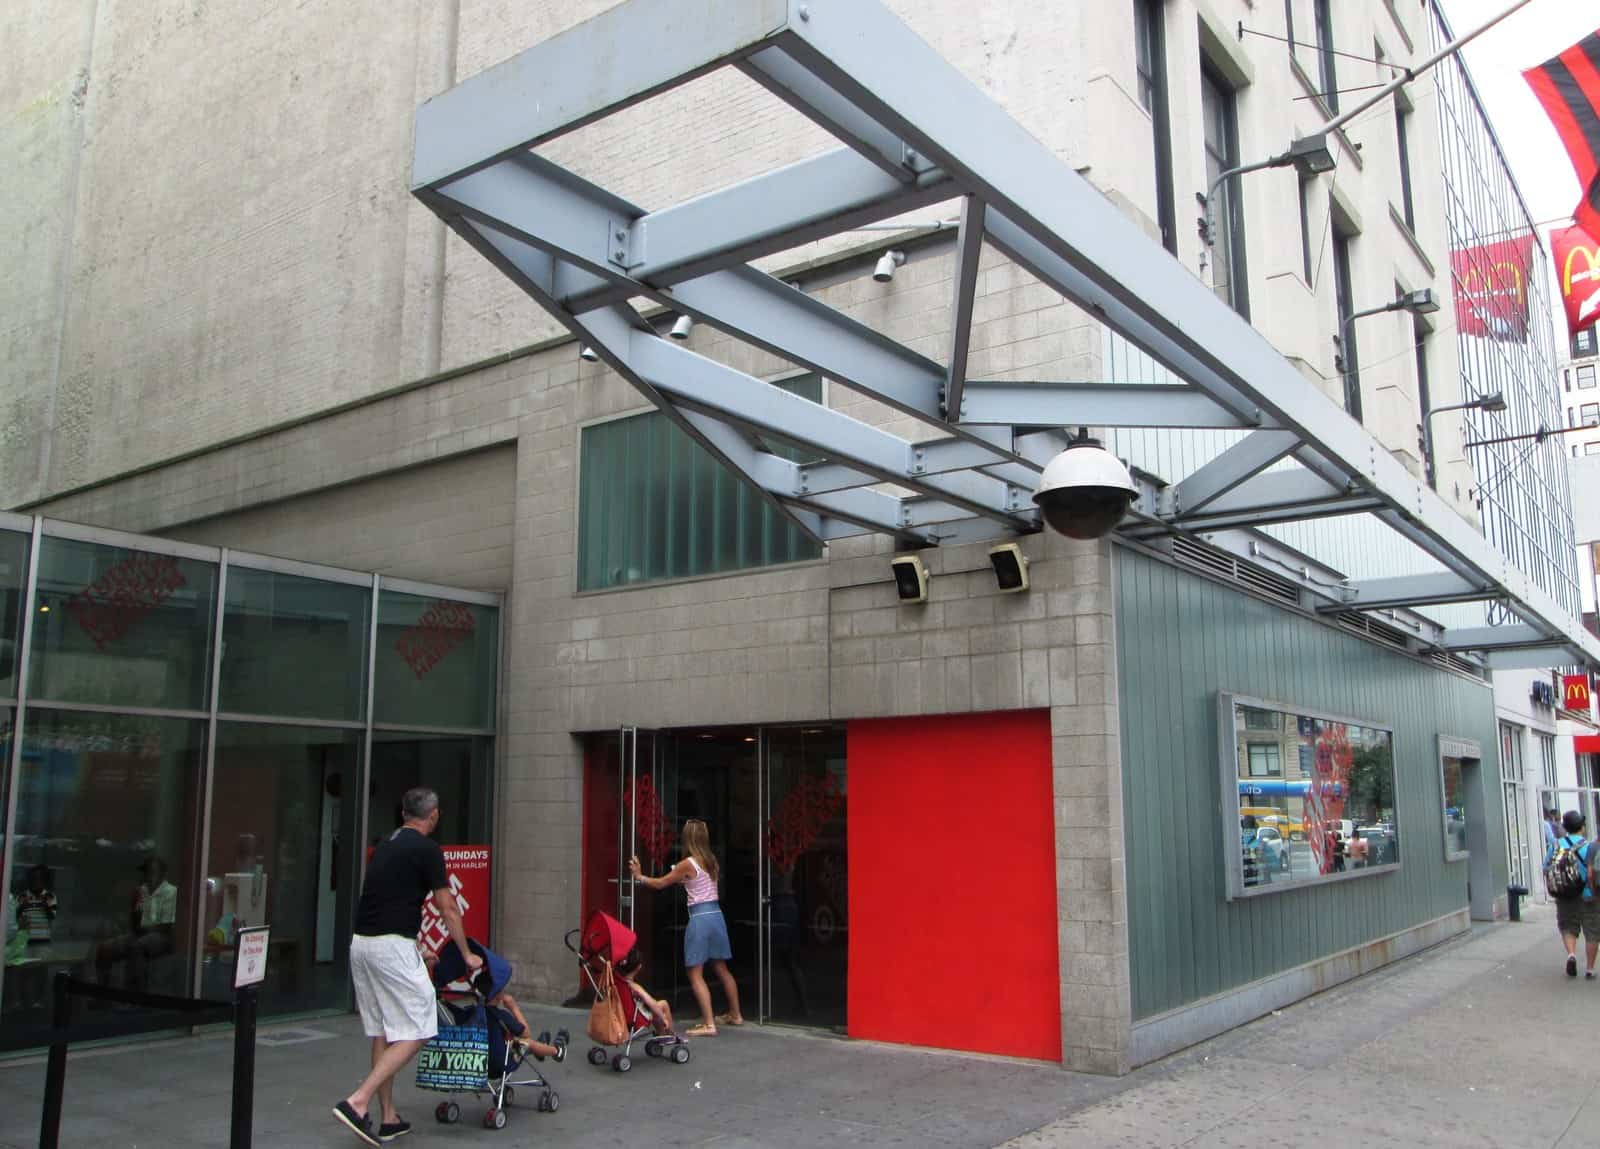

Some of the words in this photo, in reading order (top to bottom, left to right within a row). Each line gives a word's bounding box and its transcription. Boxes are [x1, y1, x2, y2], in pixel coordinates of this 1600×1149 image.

[443, 851, 488, 860] SUNDAYS
[461, 861, 488, 869] HARLEM
[418, 1051, 442, 1068] EW
[446, 1052, 486, 1072] YORK
